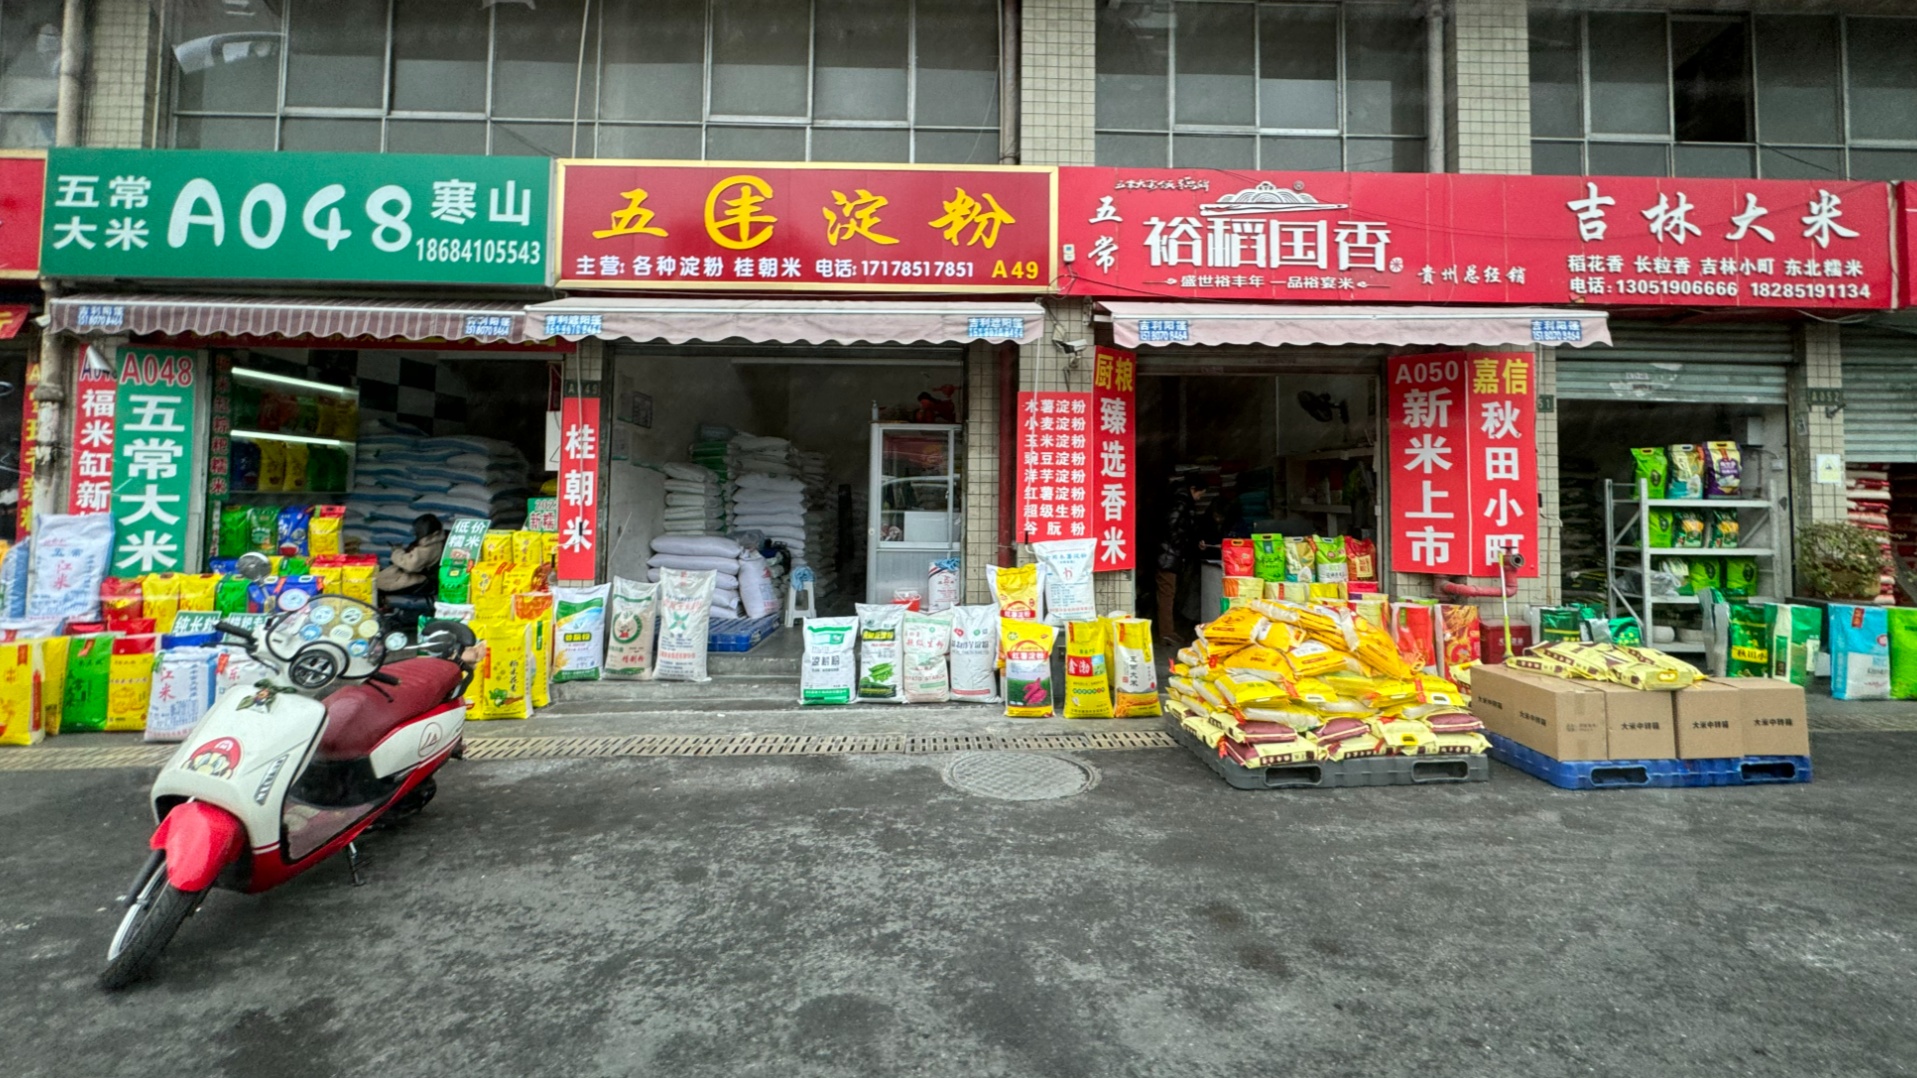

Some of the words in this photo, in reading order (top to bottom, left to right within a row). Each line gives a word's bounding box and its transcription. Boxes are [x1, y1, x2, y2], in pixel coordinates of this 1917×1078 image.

[54, 174, 152, 210] 五常
[431, 179, 531, 226] 寒山
[167, 178, 413, 252] A048
[1567, 182, 1860, 249] 吉林大米
[53, 216, 150, 251] 大米
[1087, 195, 1124, 274] 五常
[415, 238, 541, 265] 18684105543
[734, 257, 802, 277] 桂朝米
[991, 260, 1039, 279] A49
[1567, 255, 1624, 272] 稻花香
[1634, 255, 1690, 275] 长粒香
[1700, 257, 1775, 276] 吉林小町
[1784, 258, 1863, 277] 东北糯米
[1750, 282, 1871, 298] 18285191134
[120, 353, 193, 387] A048
[1095, 354, 1134, 392] 厨粮
[1395, 361, 1459, 384] A050
[1473, 358, 1529, 395] 嘉信
[1024, 399, 1086, 414] 木薯淀粉
[1024, 417, 1086, 431] 小麦淀粉
[76, 389, 116, 516] 福米缸新
[1024, 434, 1086, 448] 玉米淀粉
[1024, 452, 1086, 466] 豌豆淀粉
[116, 394, 186, 572] 五常大米
[1024, 469, 1086, 483] 洋芋淀粉
[1100, 397, 1127, 565] 臻选香米
[1402, 387, 1455, 567] 新米上市
[561, 424, 596, 553] 桂朝米
[1024, 487, 1086, 501] 红薯淀粉
[1024, 504, 1086, 518] 超级生粉
[455, 521, 486, 533] 低价
[448, 535, 480, 548] 糯米
[159, 667, 176, 702] 江米
[1621, 722, 1660, 730] 大米中转箱
[1692, 721, 1729, 729] 大米中转箱
[1754, 718, 1793, 727] 大米中转箱
